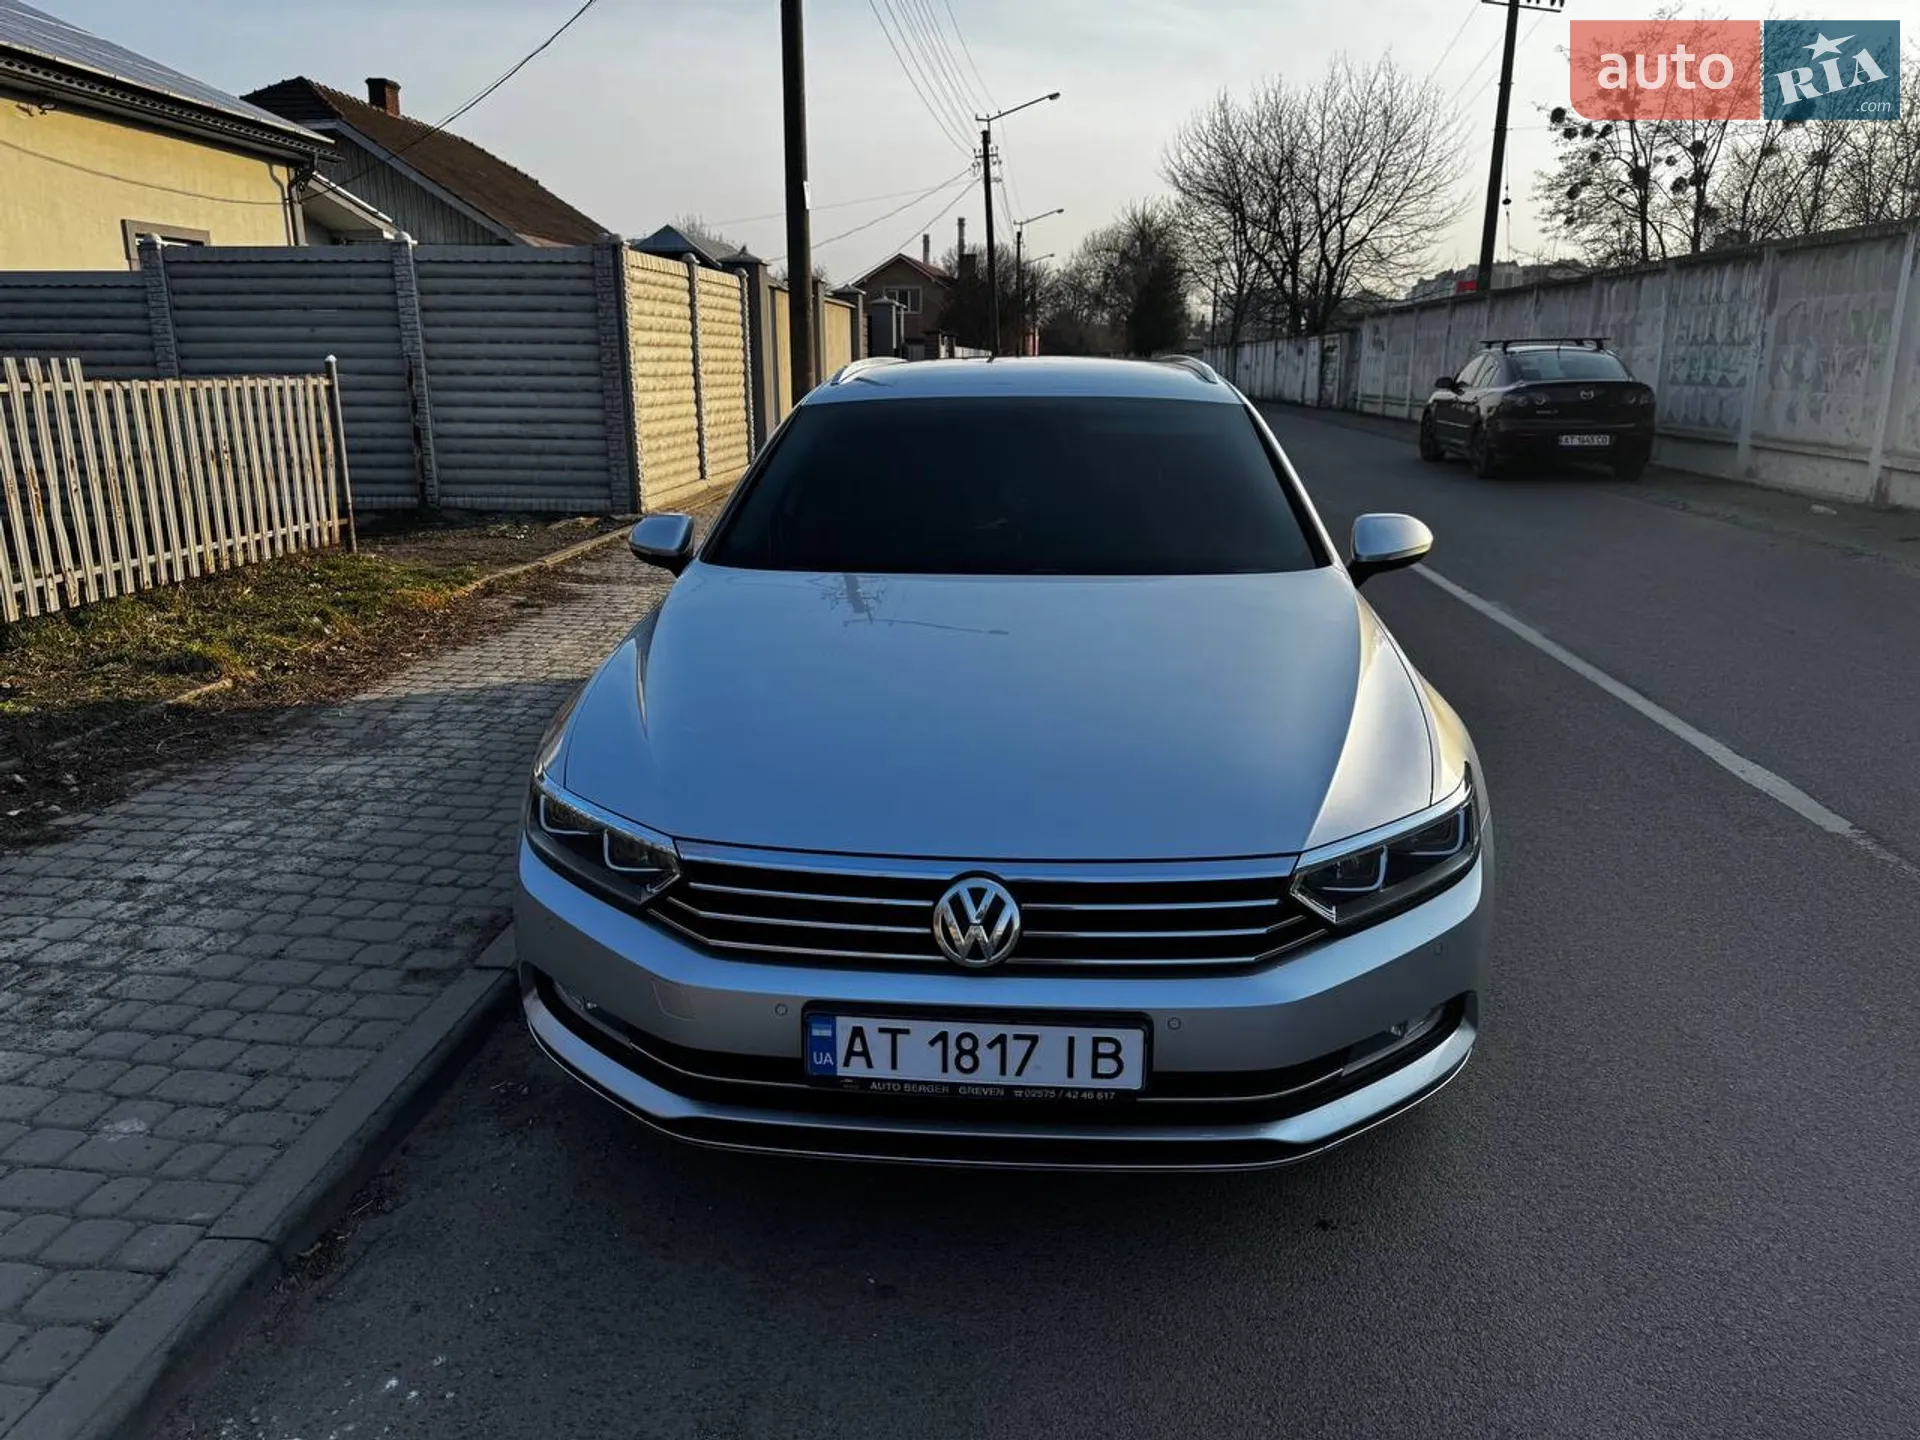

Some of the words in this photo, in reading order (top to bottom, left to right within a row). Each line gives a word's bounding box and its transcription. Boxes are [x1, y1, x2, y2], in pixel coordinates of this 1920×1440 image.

[936, 881, 1016, 963] VW
[813, 1054, 834, 1066] UA
[843, 1026, 911, 1071] AT
[928, 1031, 1039, 1077] 1817
[1066, 1035, 1125, 1081] IB
[870, 1081, 901, 1092] AUTO
[903, 1083, 949, 1094] BERGER
[959, 1086, 1004, 1096] GREVEN
